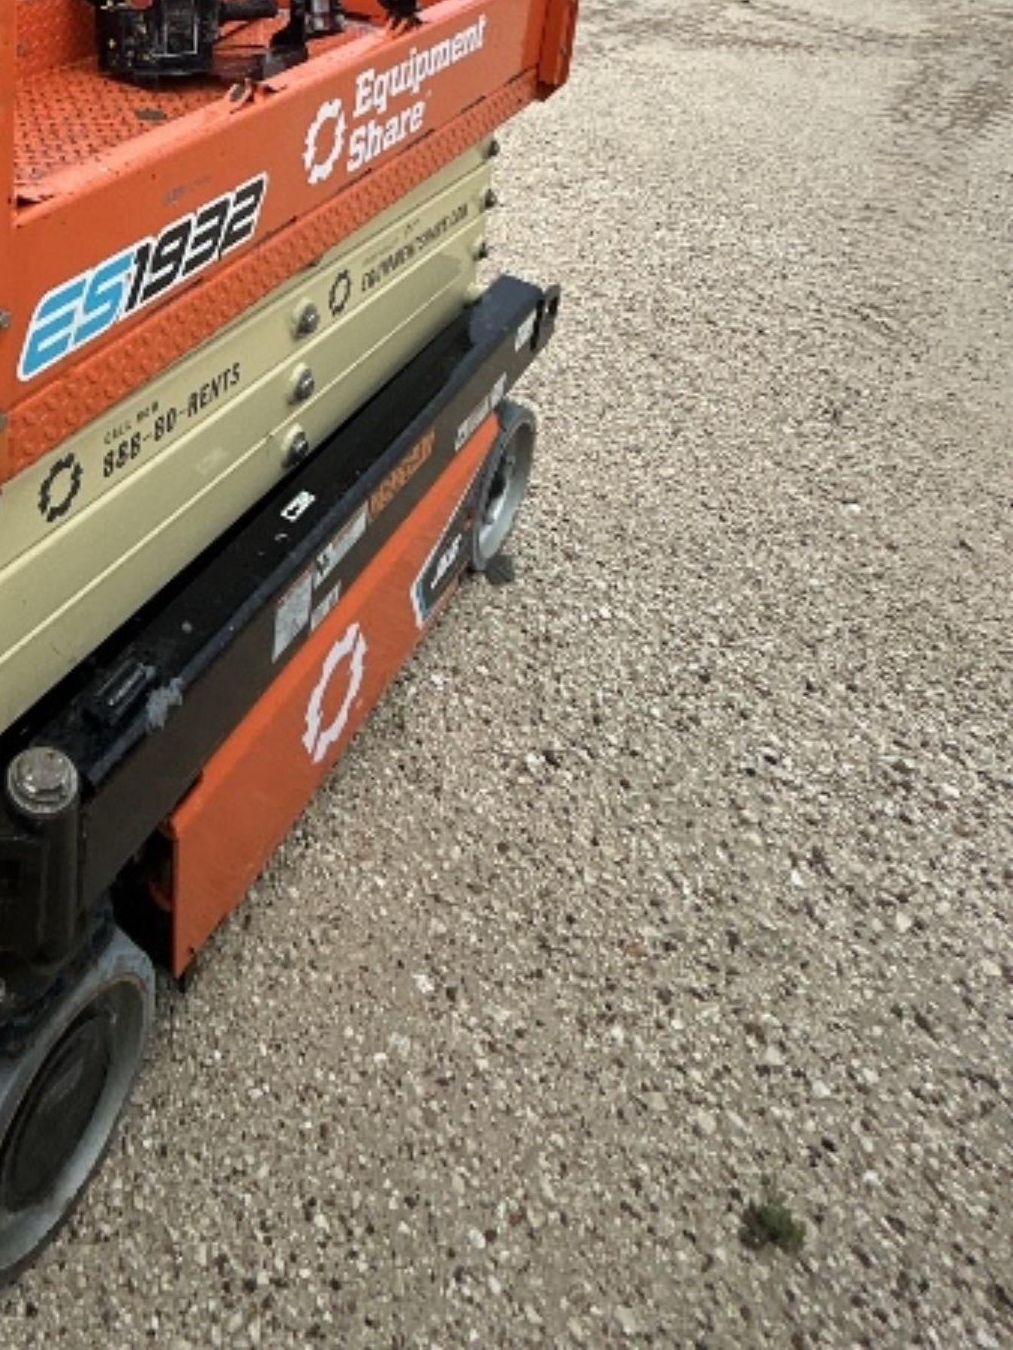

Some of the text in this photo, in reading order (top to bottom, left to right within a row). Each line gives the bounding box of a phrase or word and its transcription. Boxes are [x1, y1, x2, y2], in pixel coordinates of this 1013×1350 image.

[352, 14, 488, 119] Equipment
[346, 100, 427, 173] Share
[17, 170, 269, 382] ES1932
